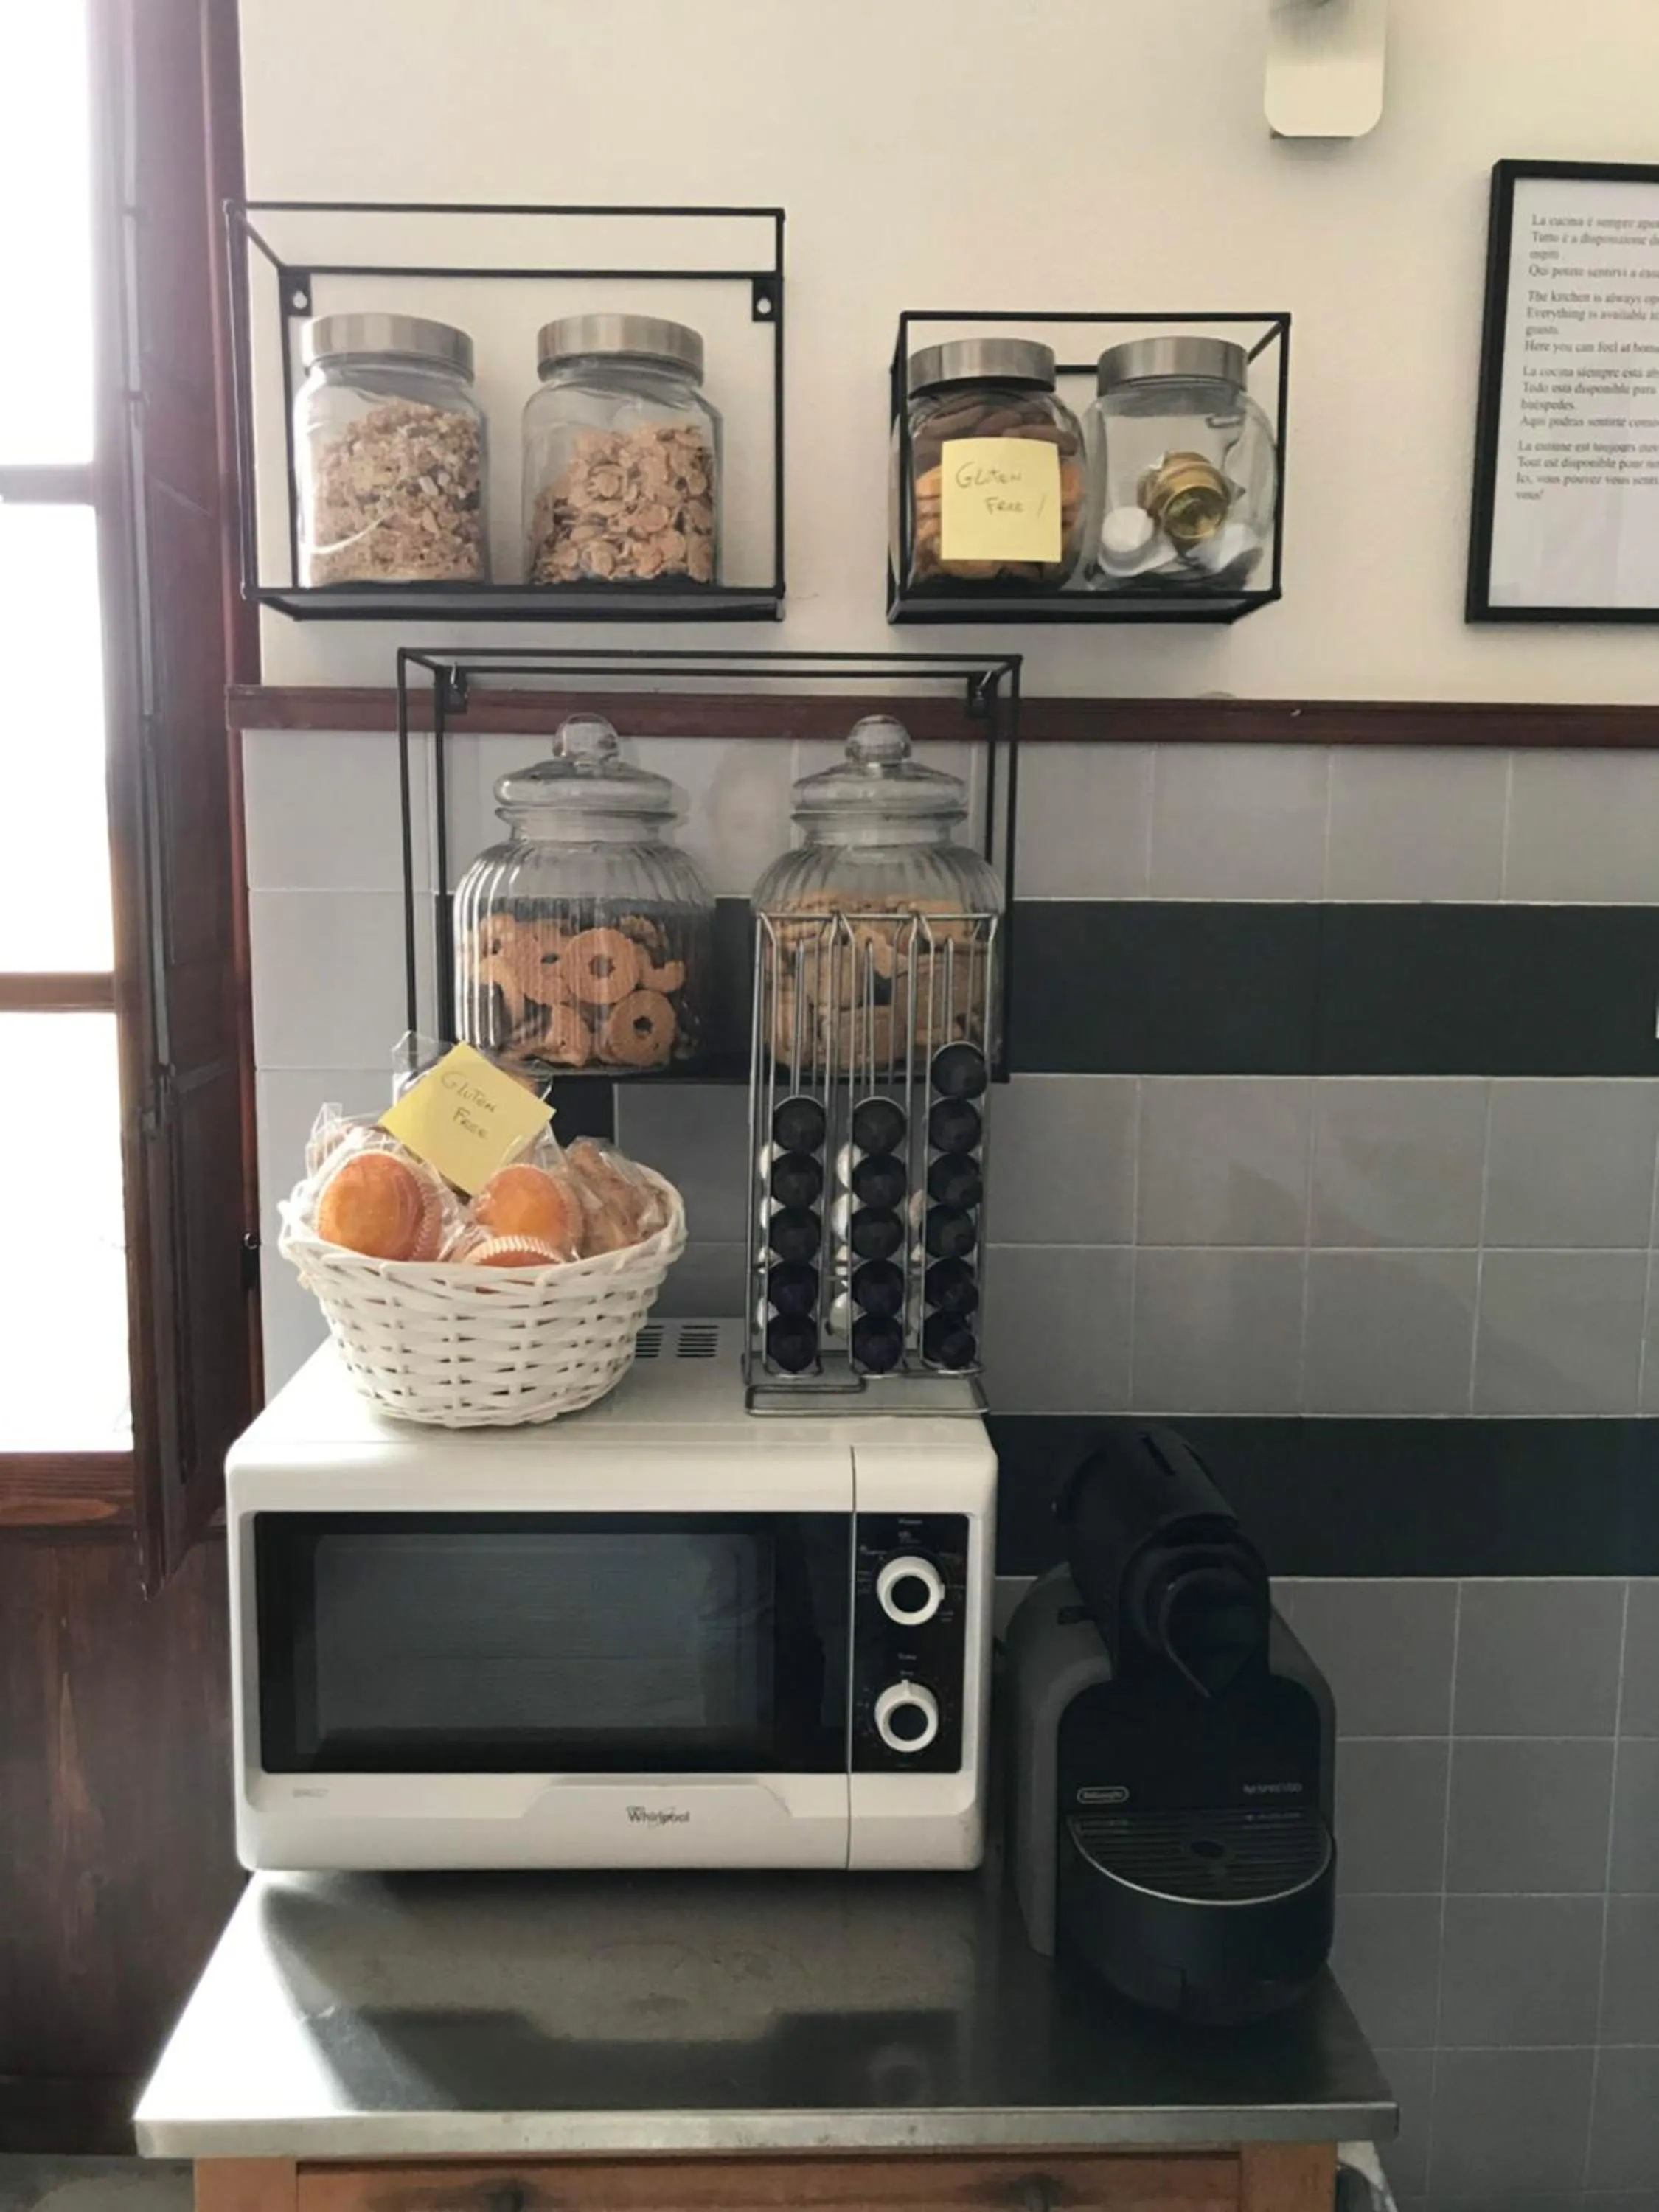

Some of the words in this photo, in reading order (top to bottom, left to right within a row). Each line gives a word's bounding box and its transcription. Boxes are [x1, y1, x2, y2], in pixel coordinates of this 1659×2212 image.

[1528, 290, 1547, 303] The
[1551, 289, 1590, 303] kitchen
[1604, 292, 1641, 306] always
[1526, 306, 1585, 322] Everything
[1524, 340, 1550, 352] Here
[626, 1806, 691, 1826] Whirlpool
